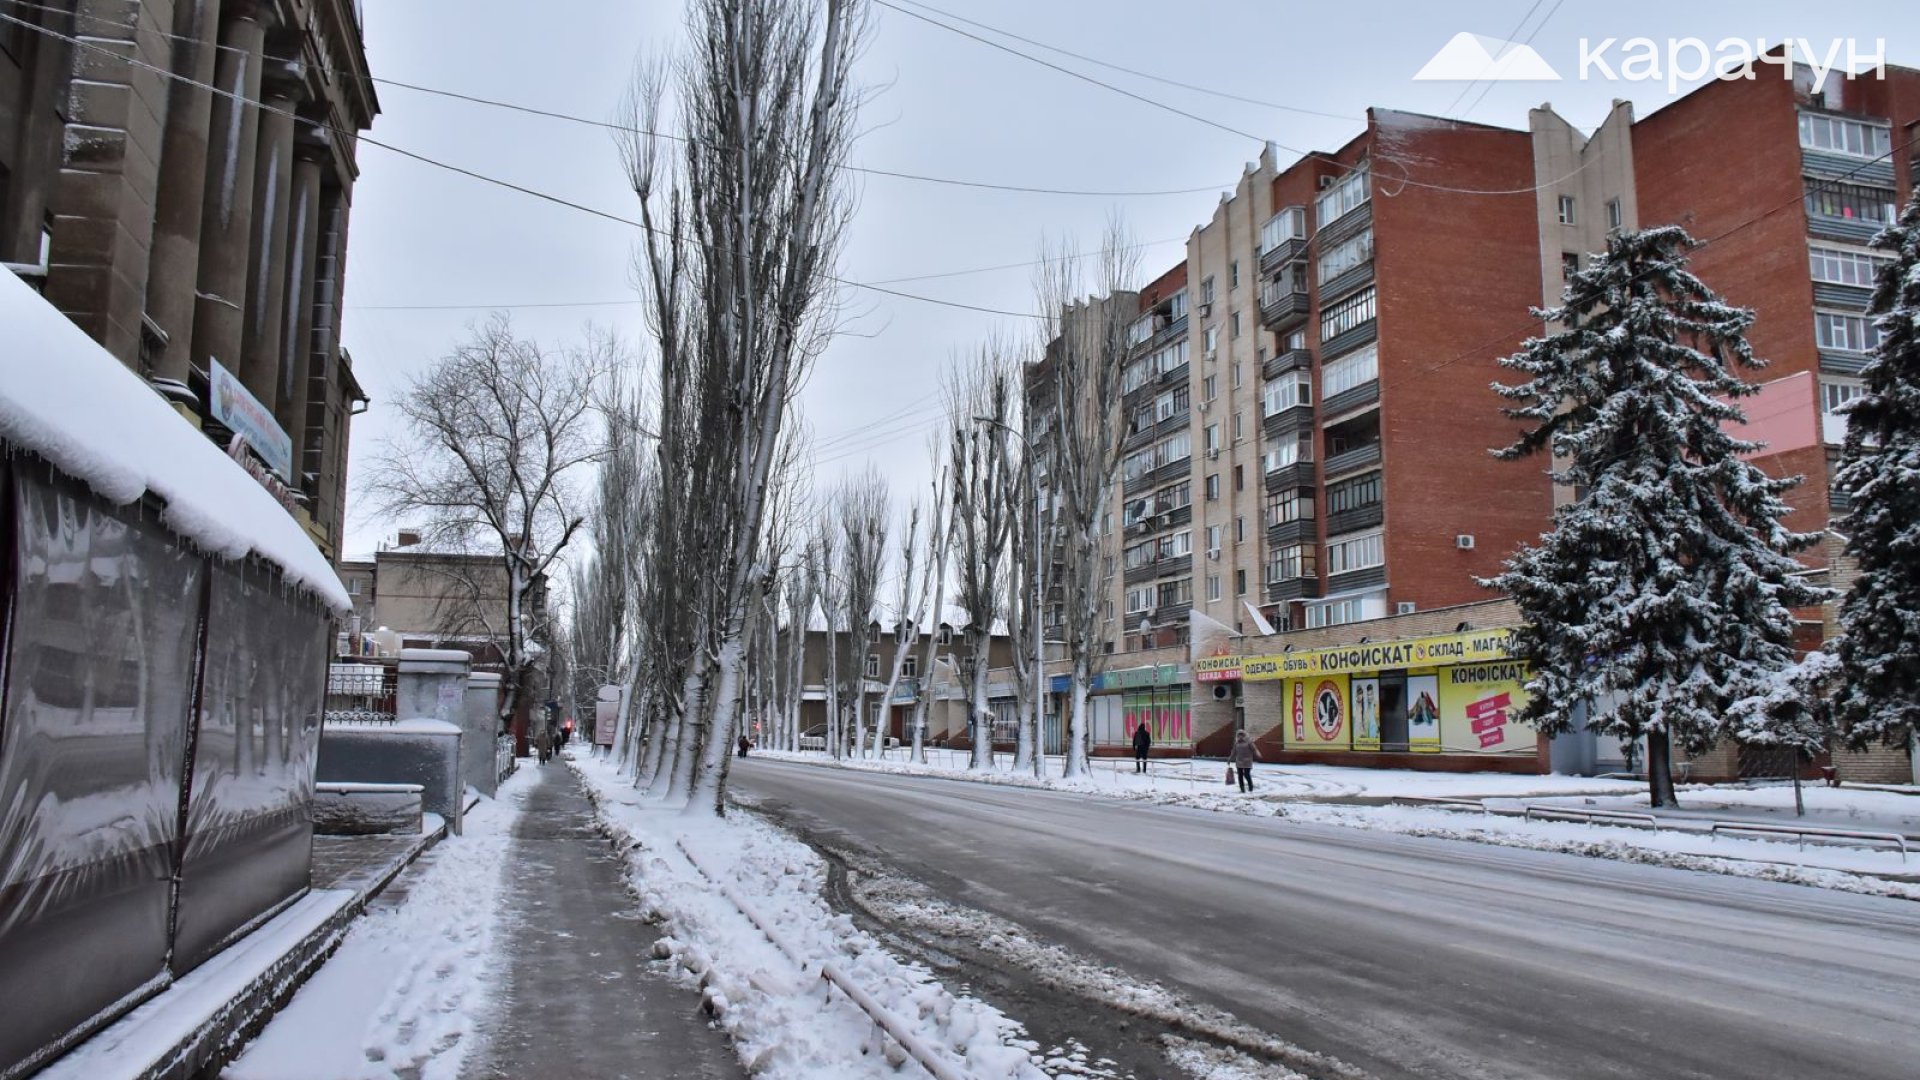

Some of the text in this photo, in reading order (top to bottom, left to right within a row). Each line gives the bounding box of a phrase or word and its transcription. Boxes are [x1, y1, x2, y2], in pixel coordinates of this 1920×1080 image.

[1197, 657, 1241, 670] КОНФИСКА
[1245, 633, 1520, 674] ОДЕЖДА ОБУВЬ КОНФИСКАТ СКЛАД МАГАЗИ
[1451, 663, 1525, 683] КОНФІСКАТ
[1295, 682, 1304, 740] ВХОД
